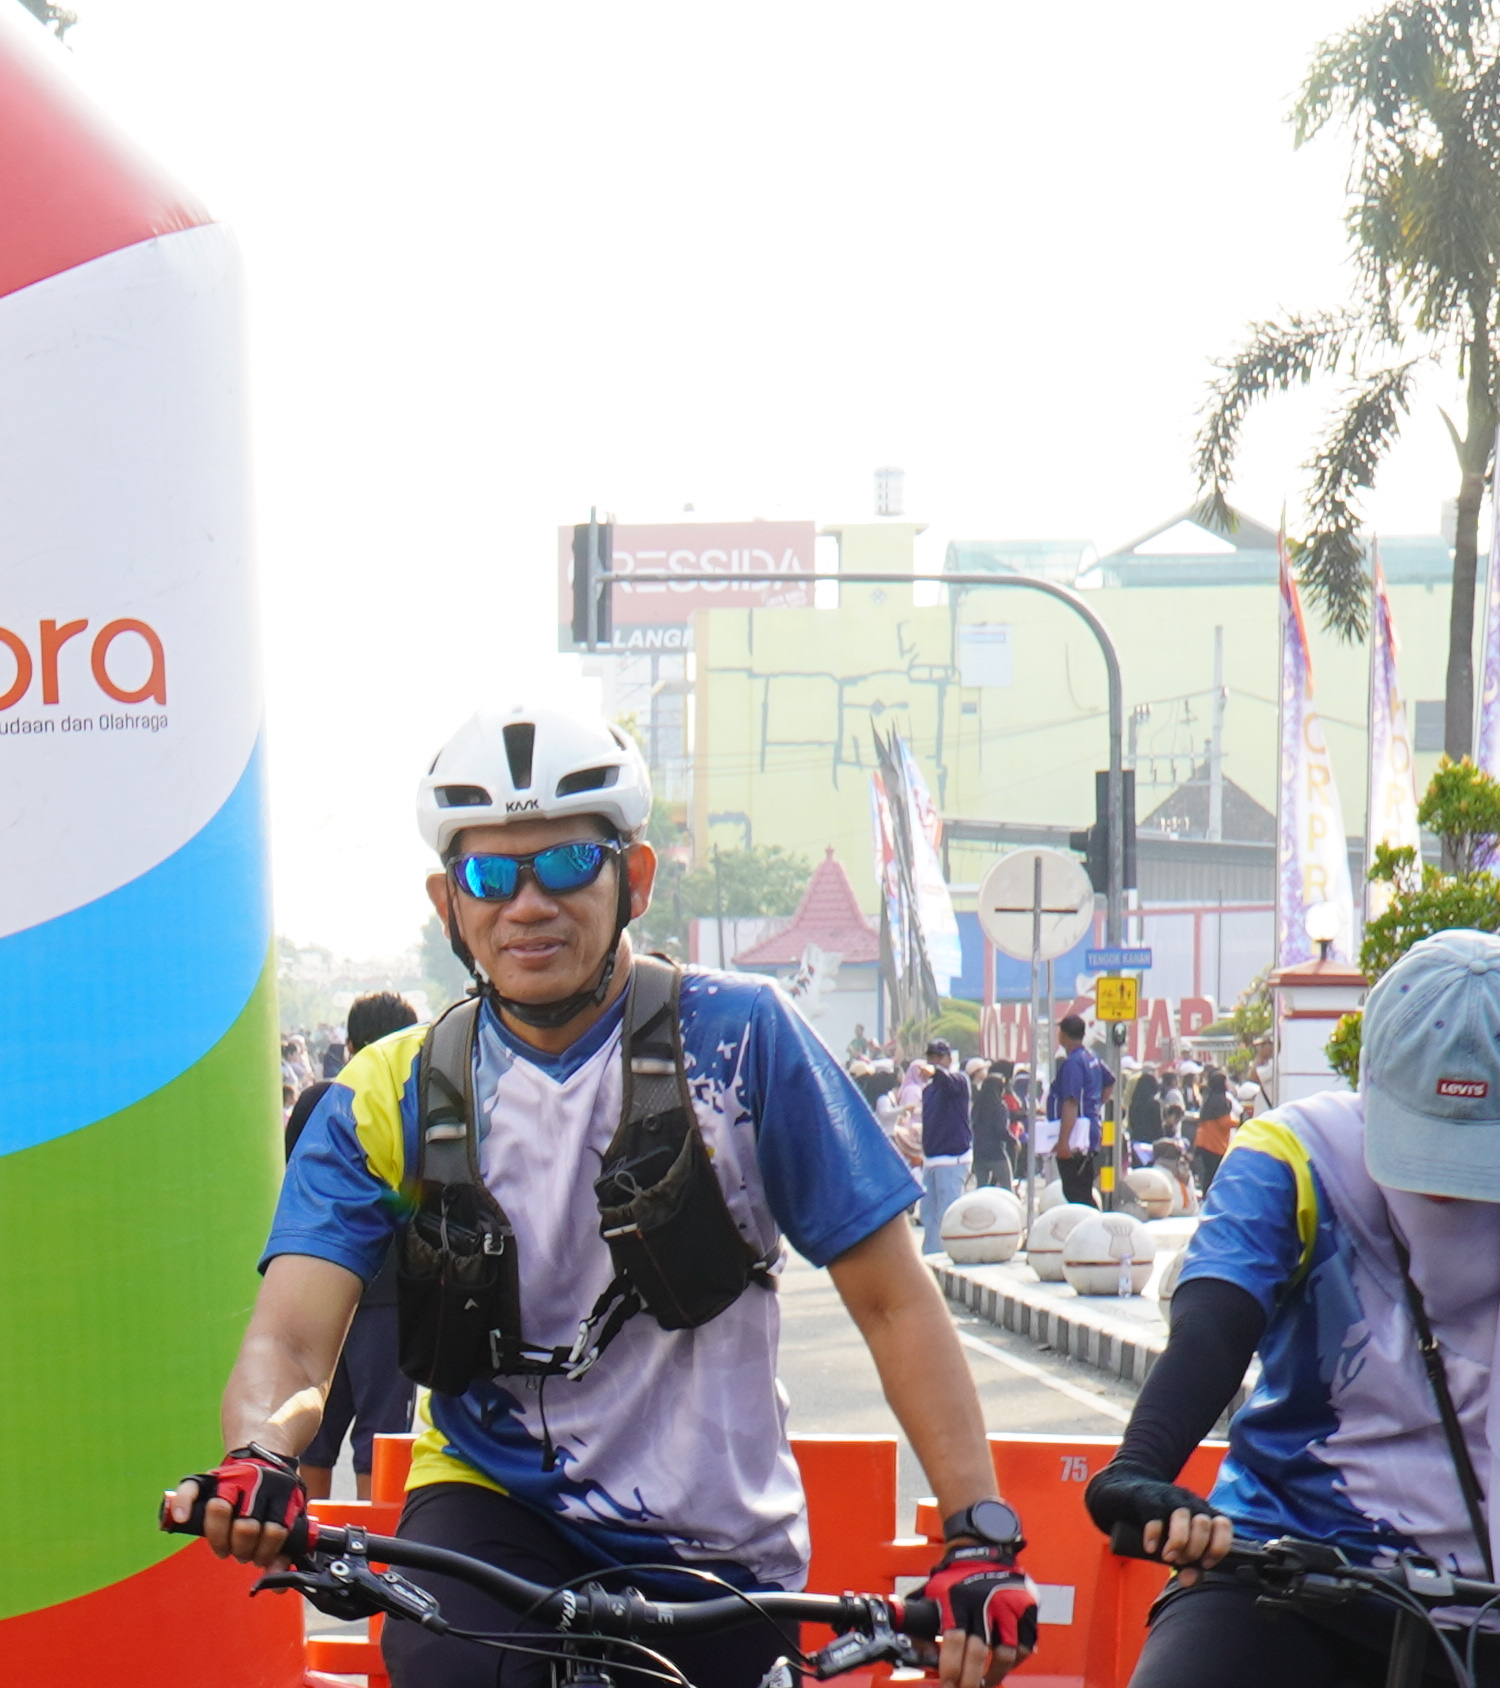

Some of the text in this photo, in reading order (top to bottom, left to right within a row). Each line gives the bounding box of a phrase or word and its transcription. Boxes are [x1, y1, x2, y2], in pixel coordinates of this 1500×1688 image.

[567, 548, 807, 593] RESSIDA
[60, 715, 94, 733] dan
[98, 712, 170, 734] Olahraga
[1060, 1455, 1089, 1483] 75
